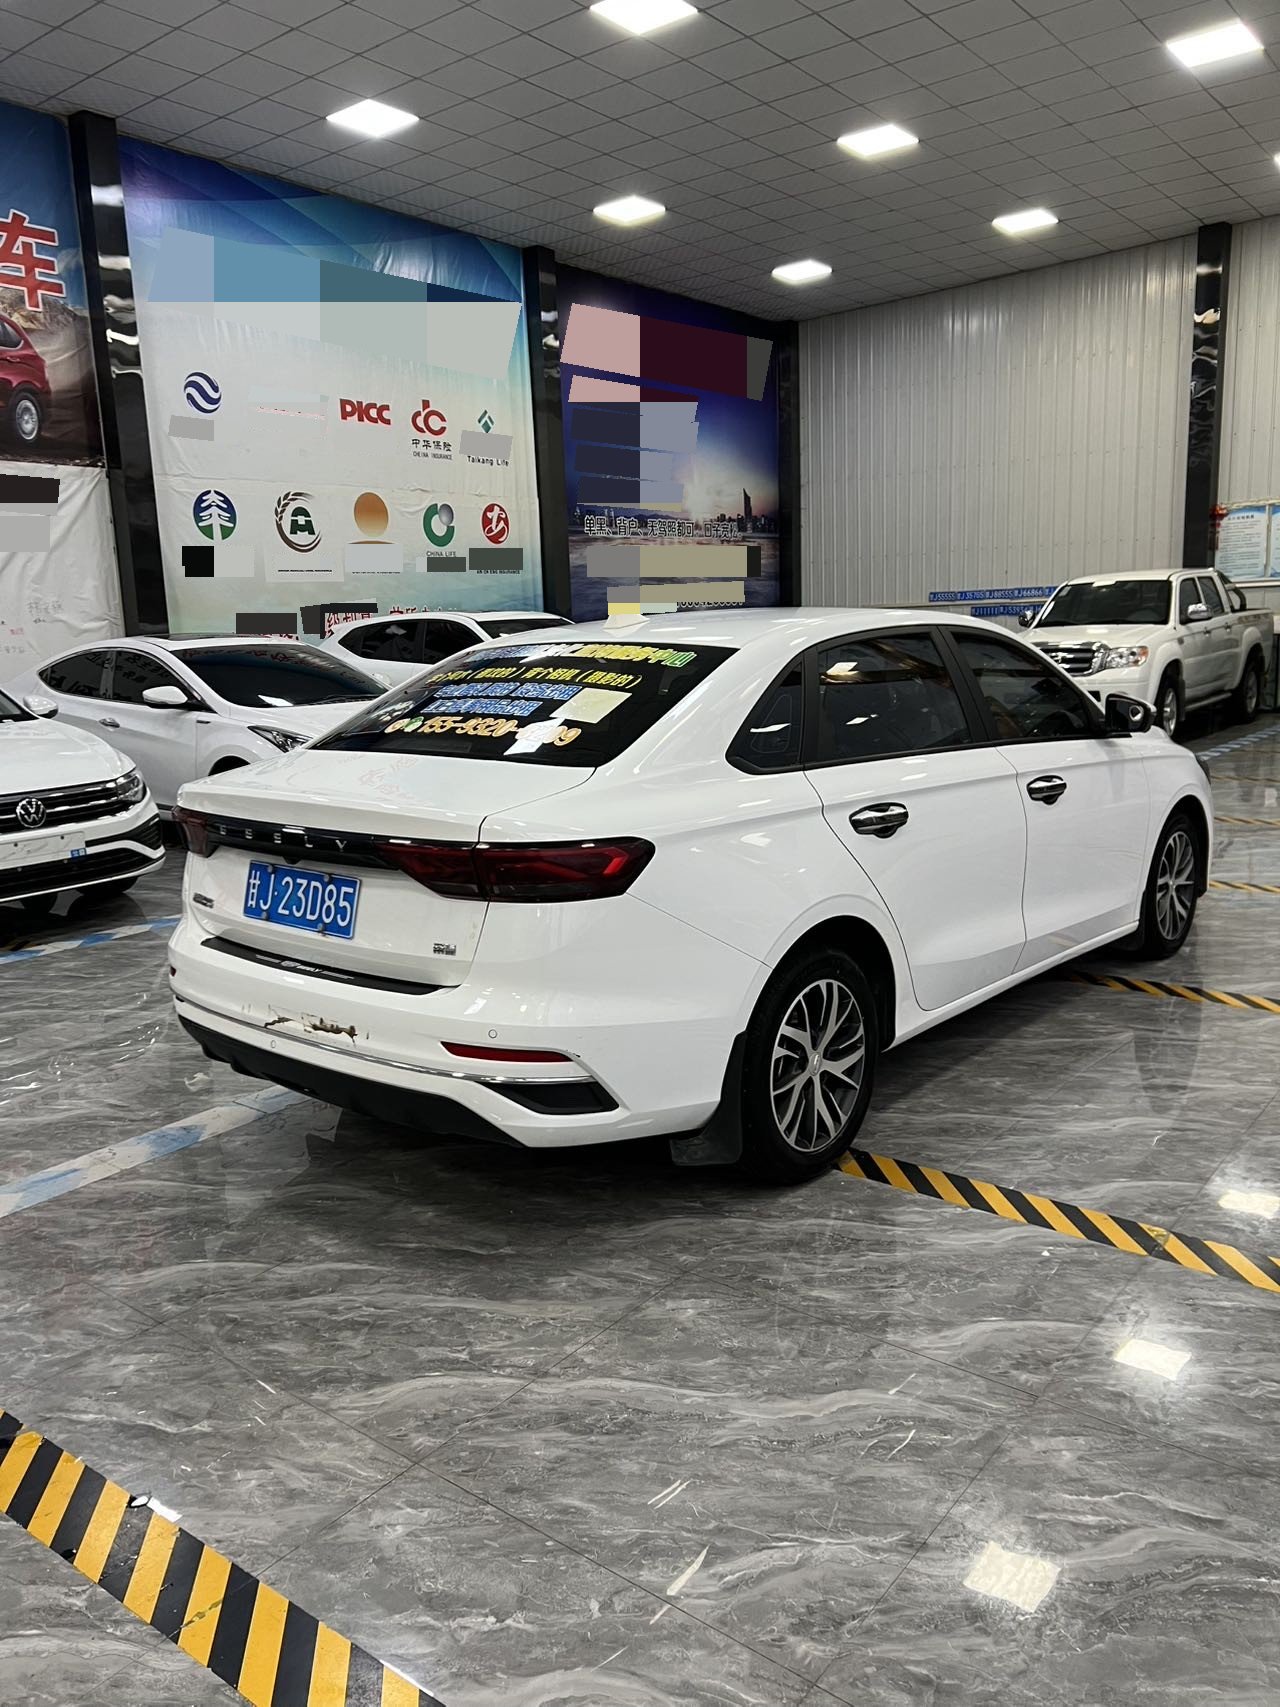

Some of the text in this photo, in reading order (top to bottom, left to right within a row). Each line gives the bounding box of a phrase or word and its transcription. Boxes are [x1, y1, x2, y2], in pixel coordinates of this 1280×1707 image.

[339, 398, 392, 426] PICC
[411, 438, 453, 452] 中华保险
[467, 455, 509, 467] Taikang Life
[426, 550, 444, 558] CHINA
